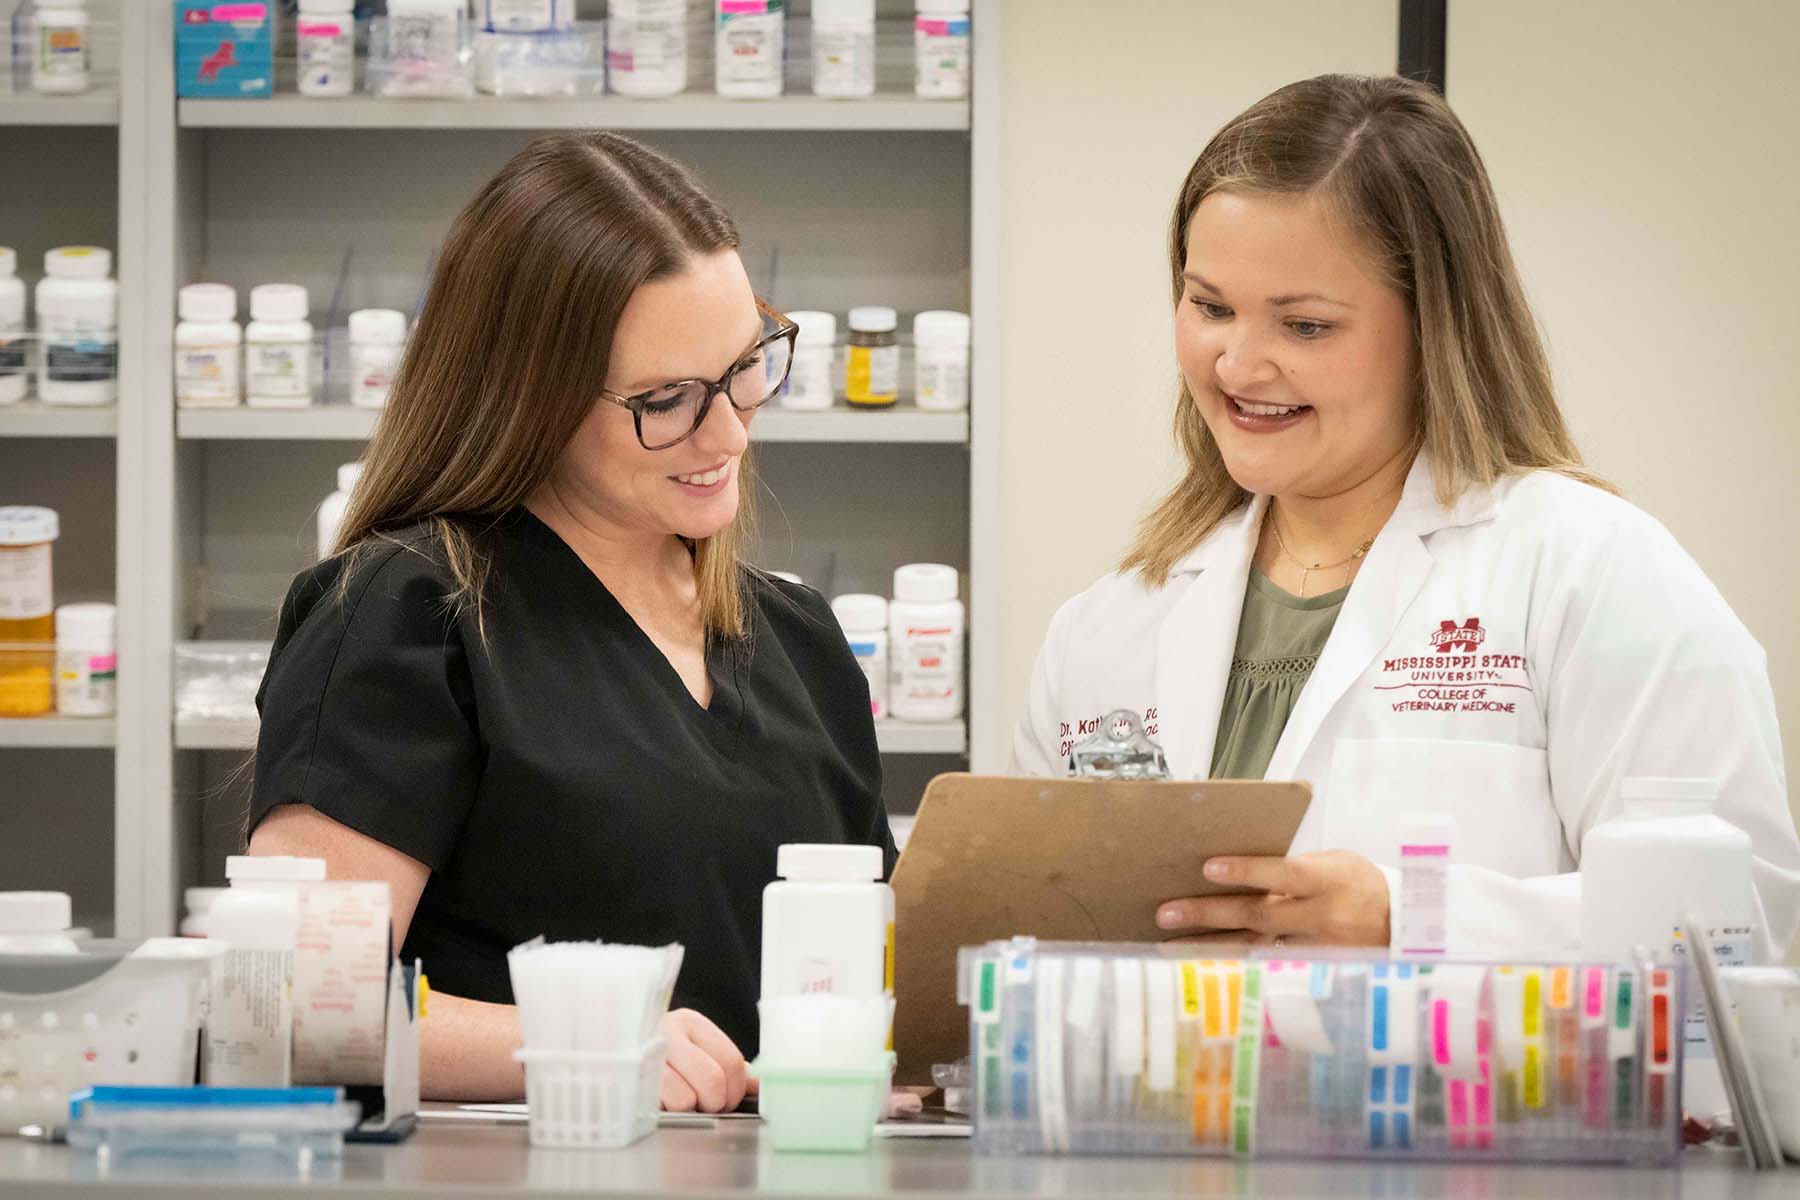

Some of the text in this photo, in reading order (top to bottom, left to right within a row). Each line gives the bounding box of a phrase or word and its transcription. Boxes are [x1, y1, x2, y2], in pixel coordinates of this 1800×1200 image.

[1440, 630, 1478, 642] STATE
[1383, 656, 1477, 672] MISSISSIPPI
[1411, 671, 1495, 681] UNIVERSITY
[1418, 688, 1487, 700] COLLEGE OF
[1392, 701, 1517, 713] VETERINARY MEDICINE
